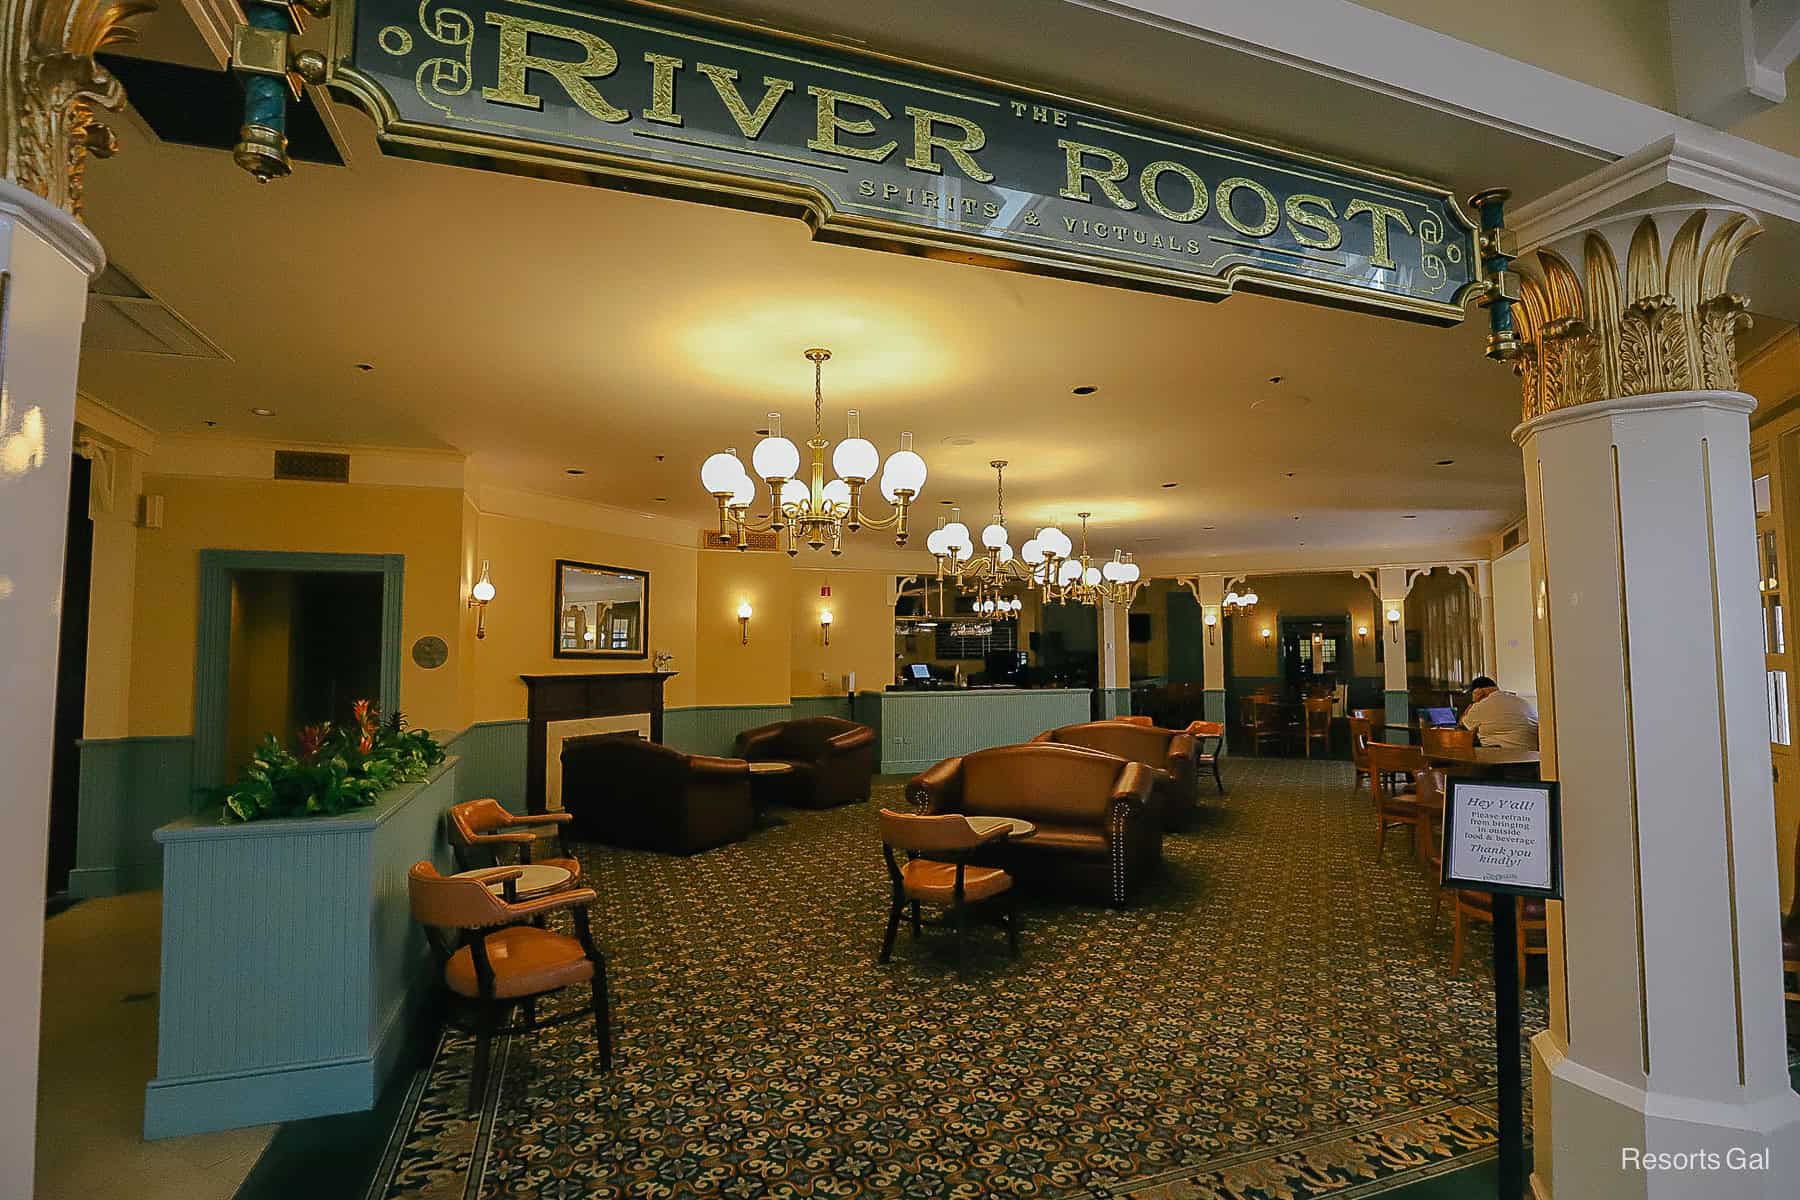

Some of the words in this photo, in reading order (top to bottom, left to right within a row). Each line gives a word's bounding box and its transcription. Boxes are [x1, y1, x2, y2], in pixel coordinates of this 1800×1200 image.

[1010, 101, 1069, 128] THE
[481, 11, 994, 183] RIVER
[1057, 138, 1416, 270] ROOST
[858, 178, 1000, 219] SPIRITS
[1022, 208, 1041, 227] &
[1062, 217, 1200, 255] VICTUALS
[1467, 798, 1494, 809] Hey
[1499, 800, 1534, 810] Y'all!
[1470, 818, 1490, 826] from
[1492, 821, 1530, 830] bringing
[1464, 832, 1484, 840] food
[1496, 836, 1536, 845] beverage
[1470, 844, 1506, 855] Thank
[1509, 847, 1532, 857] you
[1479, 855, 1521, 867] kindly!
